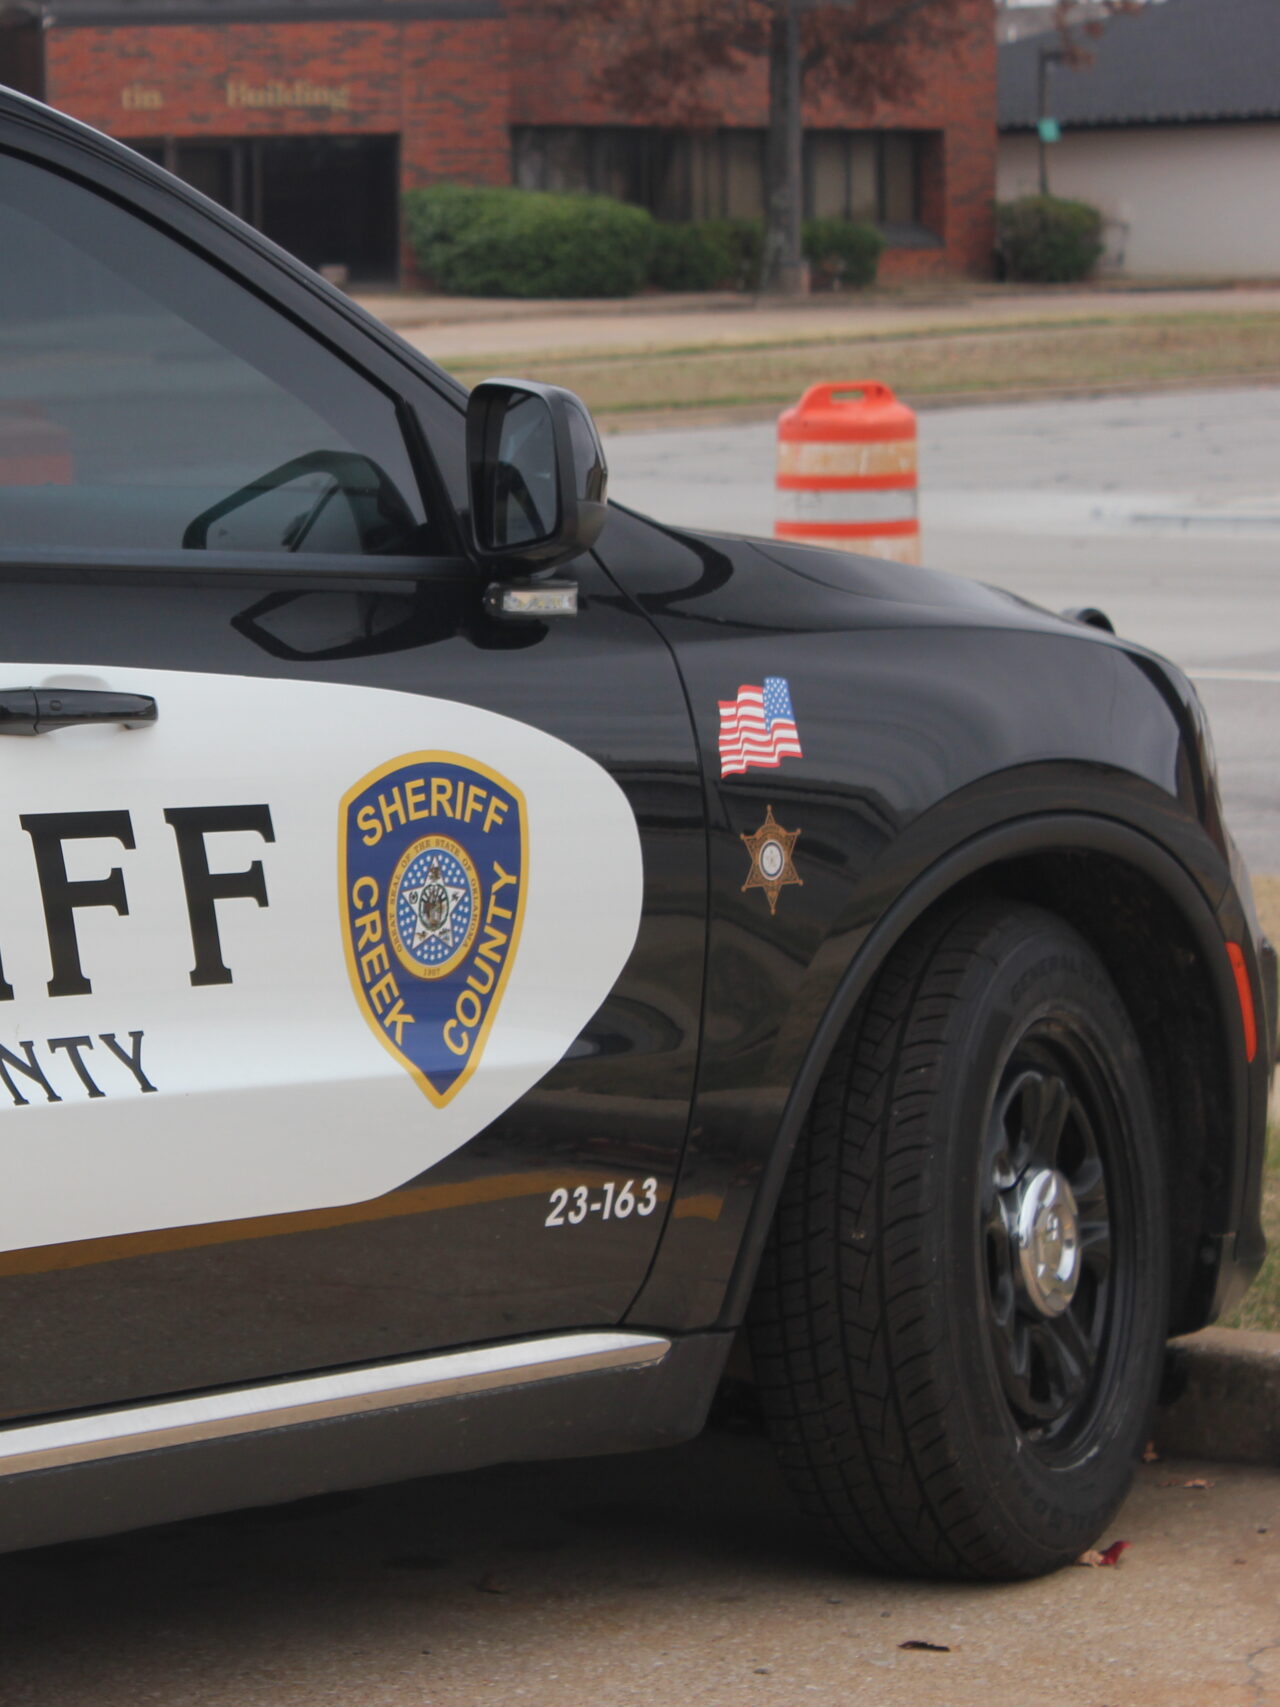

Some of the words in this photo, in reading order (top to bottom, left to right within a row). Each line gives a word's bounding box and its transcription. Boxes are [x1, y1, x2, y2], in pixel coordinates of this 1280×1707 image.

[226, 80, 352, 112] Building
[356, 777, 509, 847] SHERIFF
[414, 839, 431, 855] THE
[435, 839, 461, 857] STATE
[352, 875, 415, 1046] CREEK
[443, 861, 518, 1056] COUNTY
[544, 1176, 658, 1228] 23-163
